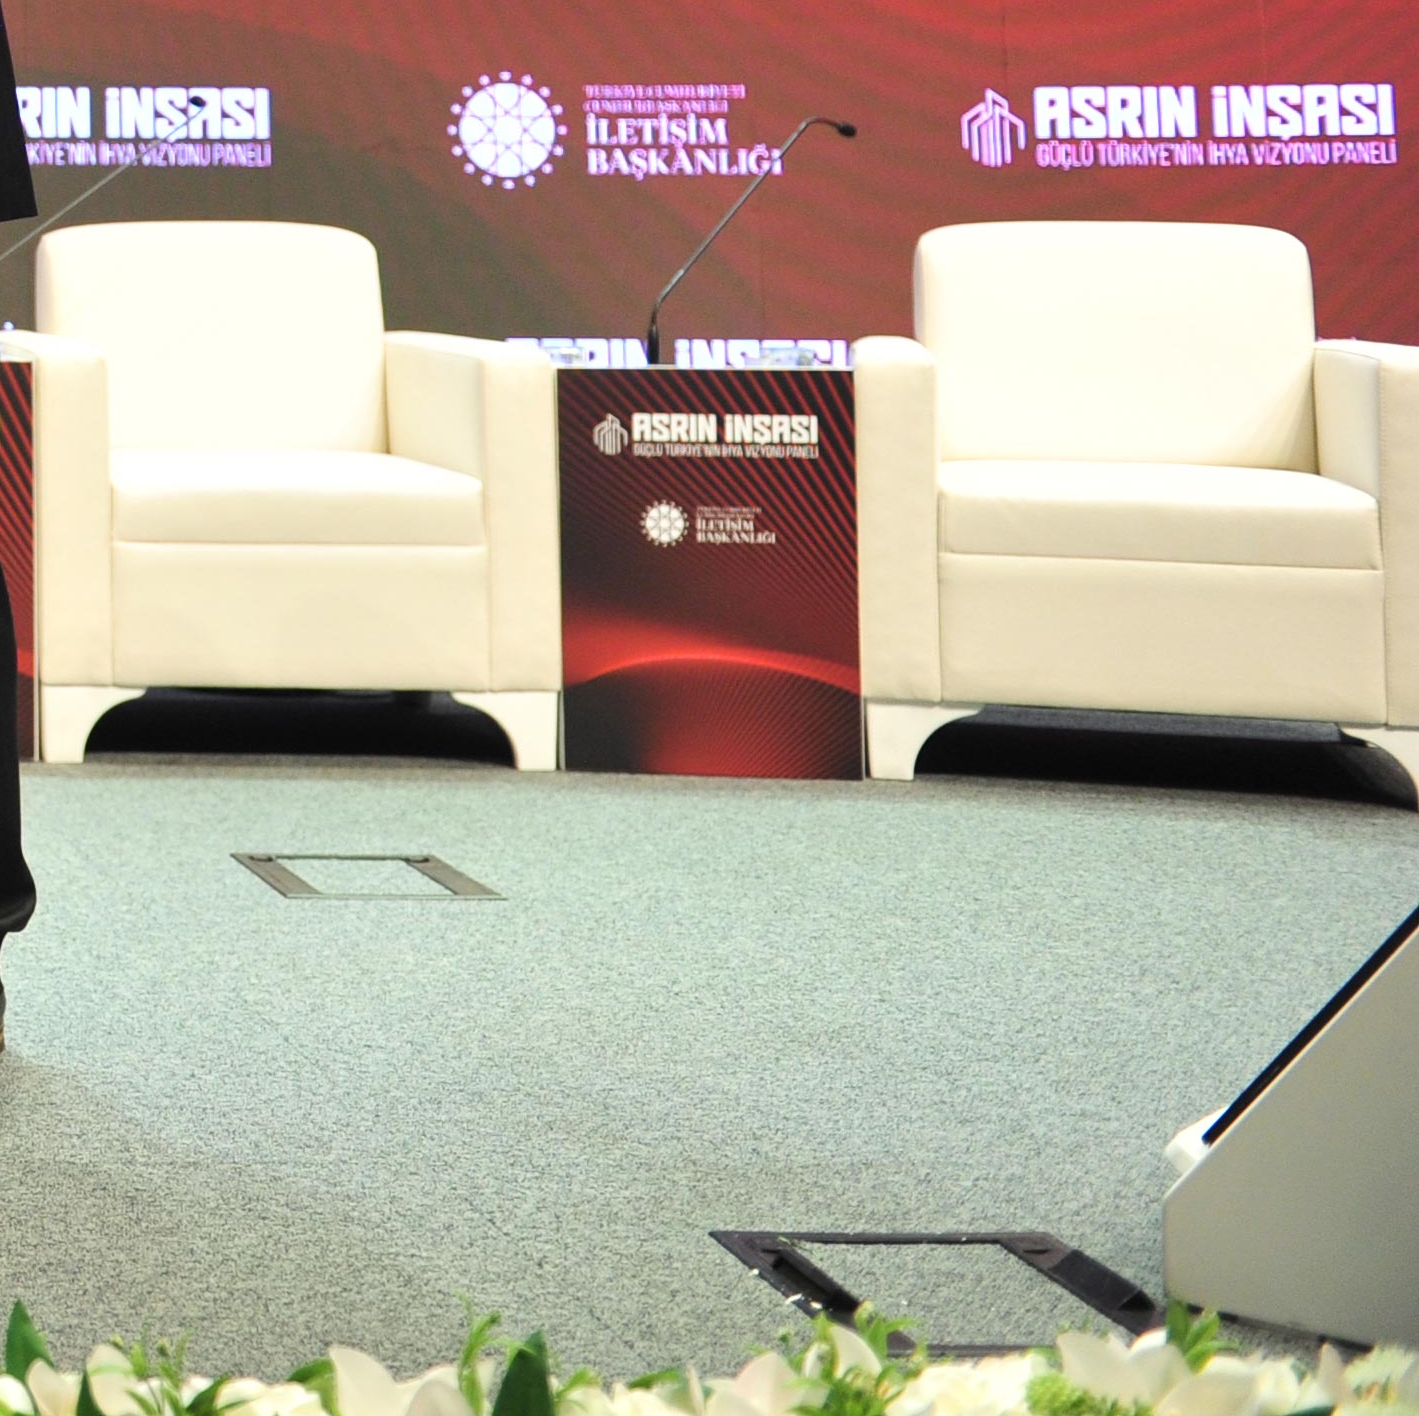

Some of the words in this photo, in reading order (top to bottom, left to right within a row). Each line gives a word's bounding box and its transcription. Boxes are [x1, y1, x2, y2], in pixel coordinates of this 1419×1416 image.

[16, 86, 91, 138] RIN
[585, 113, 728, 149] İLETİŞİM
[1033, 85, 1198, 140] ASRIN
[631, 412, 718, 442] ASRIN
